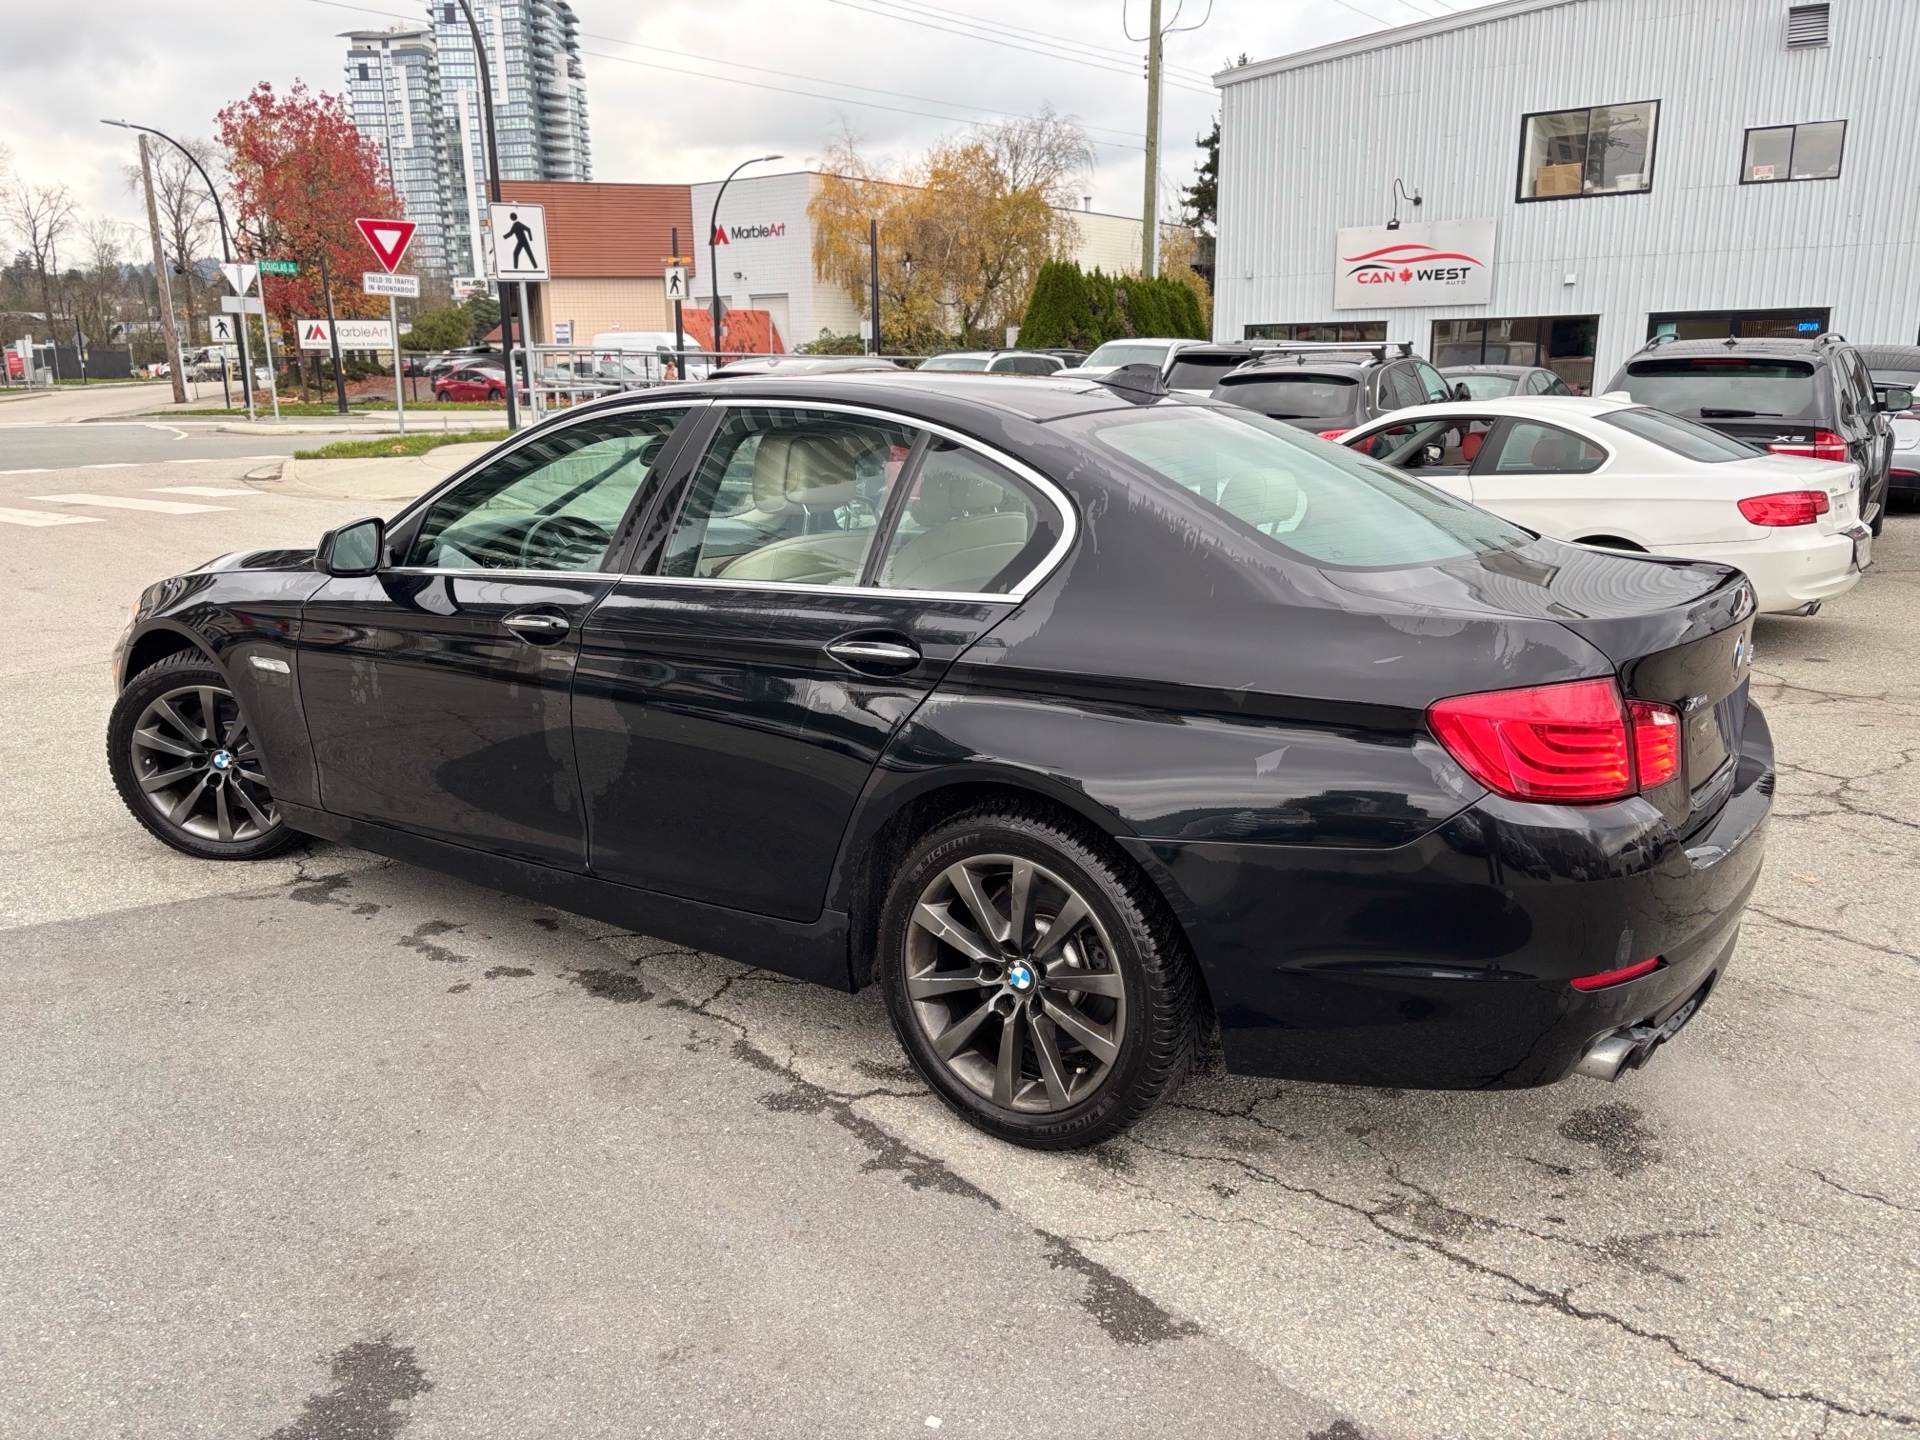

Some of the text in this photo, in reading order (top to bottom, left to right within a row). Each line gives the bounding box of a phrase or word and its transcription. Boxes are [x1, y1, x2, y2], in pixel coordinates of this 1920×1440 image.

[731, 222, 786, 240] MarbleArt
[261, 262, 288, 273] DOUGLAS
[367, 276, 383, 284] YIELD
[394, 278, 415, 286] TRAFFIC
[1357, 267, 1472, 284] CAN WEST
[377, 285, 416, 294] ROUNDABOUT
[920, 833, 979, 870] MICHELIN
